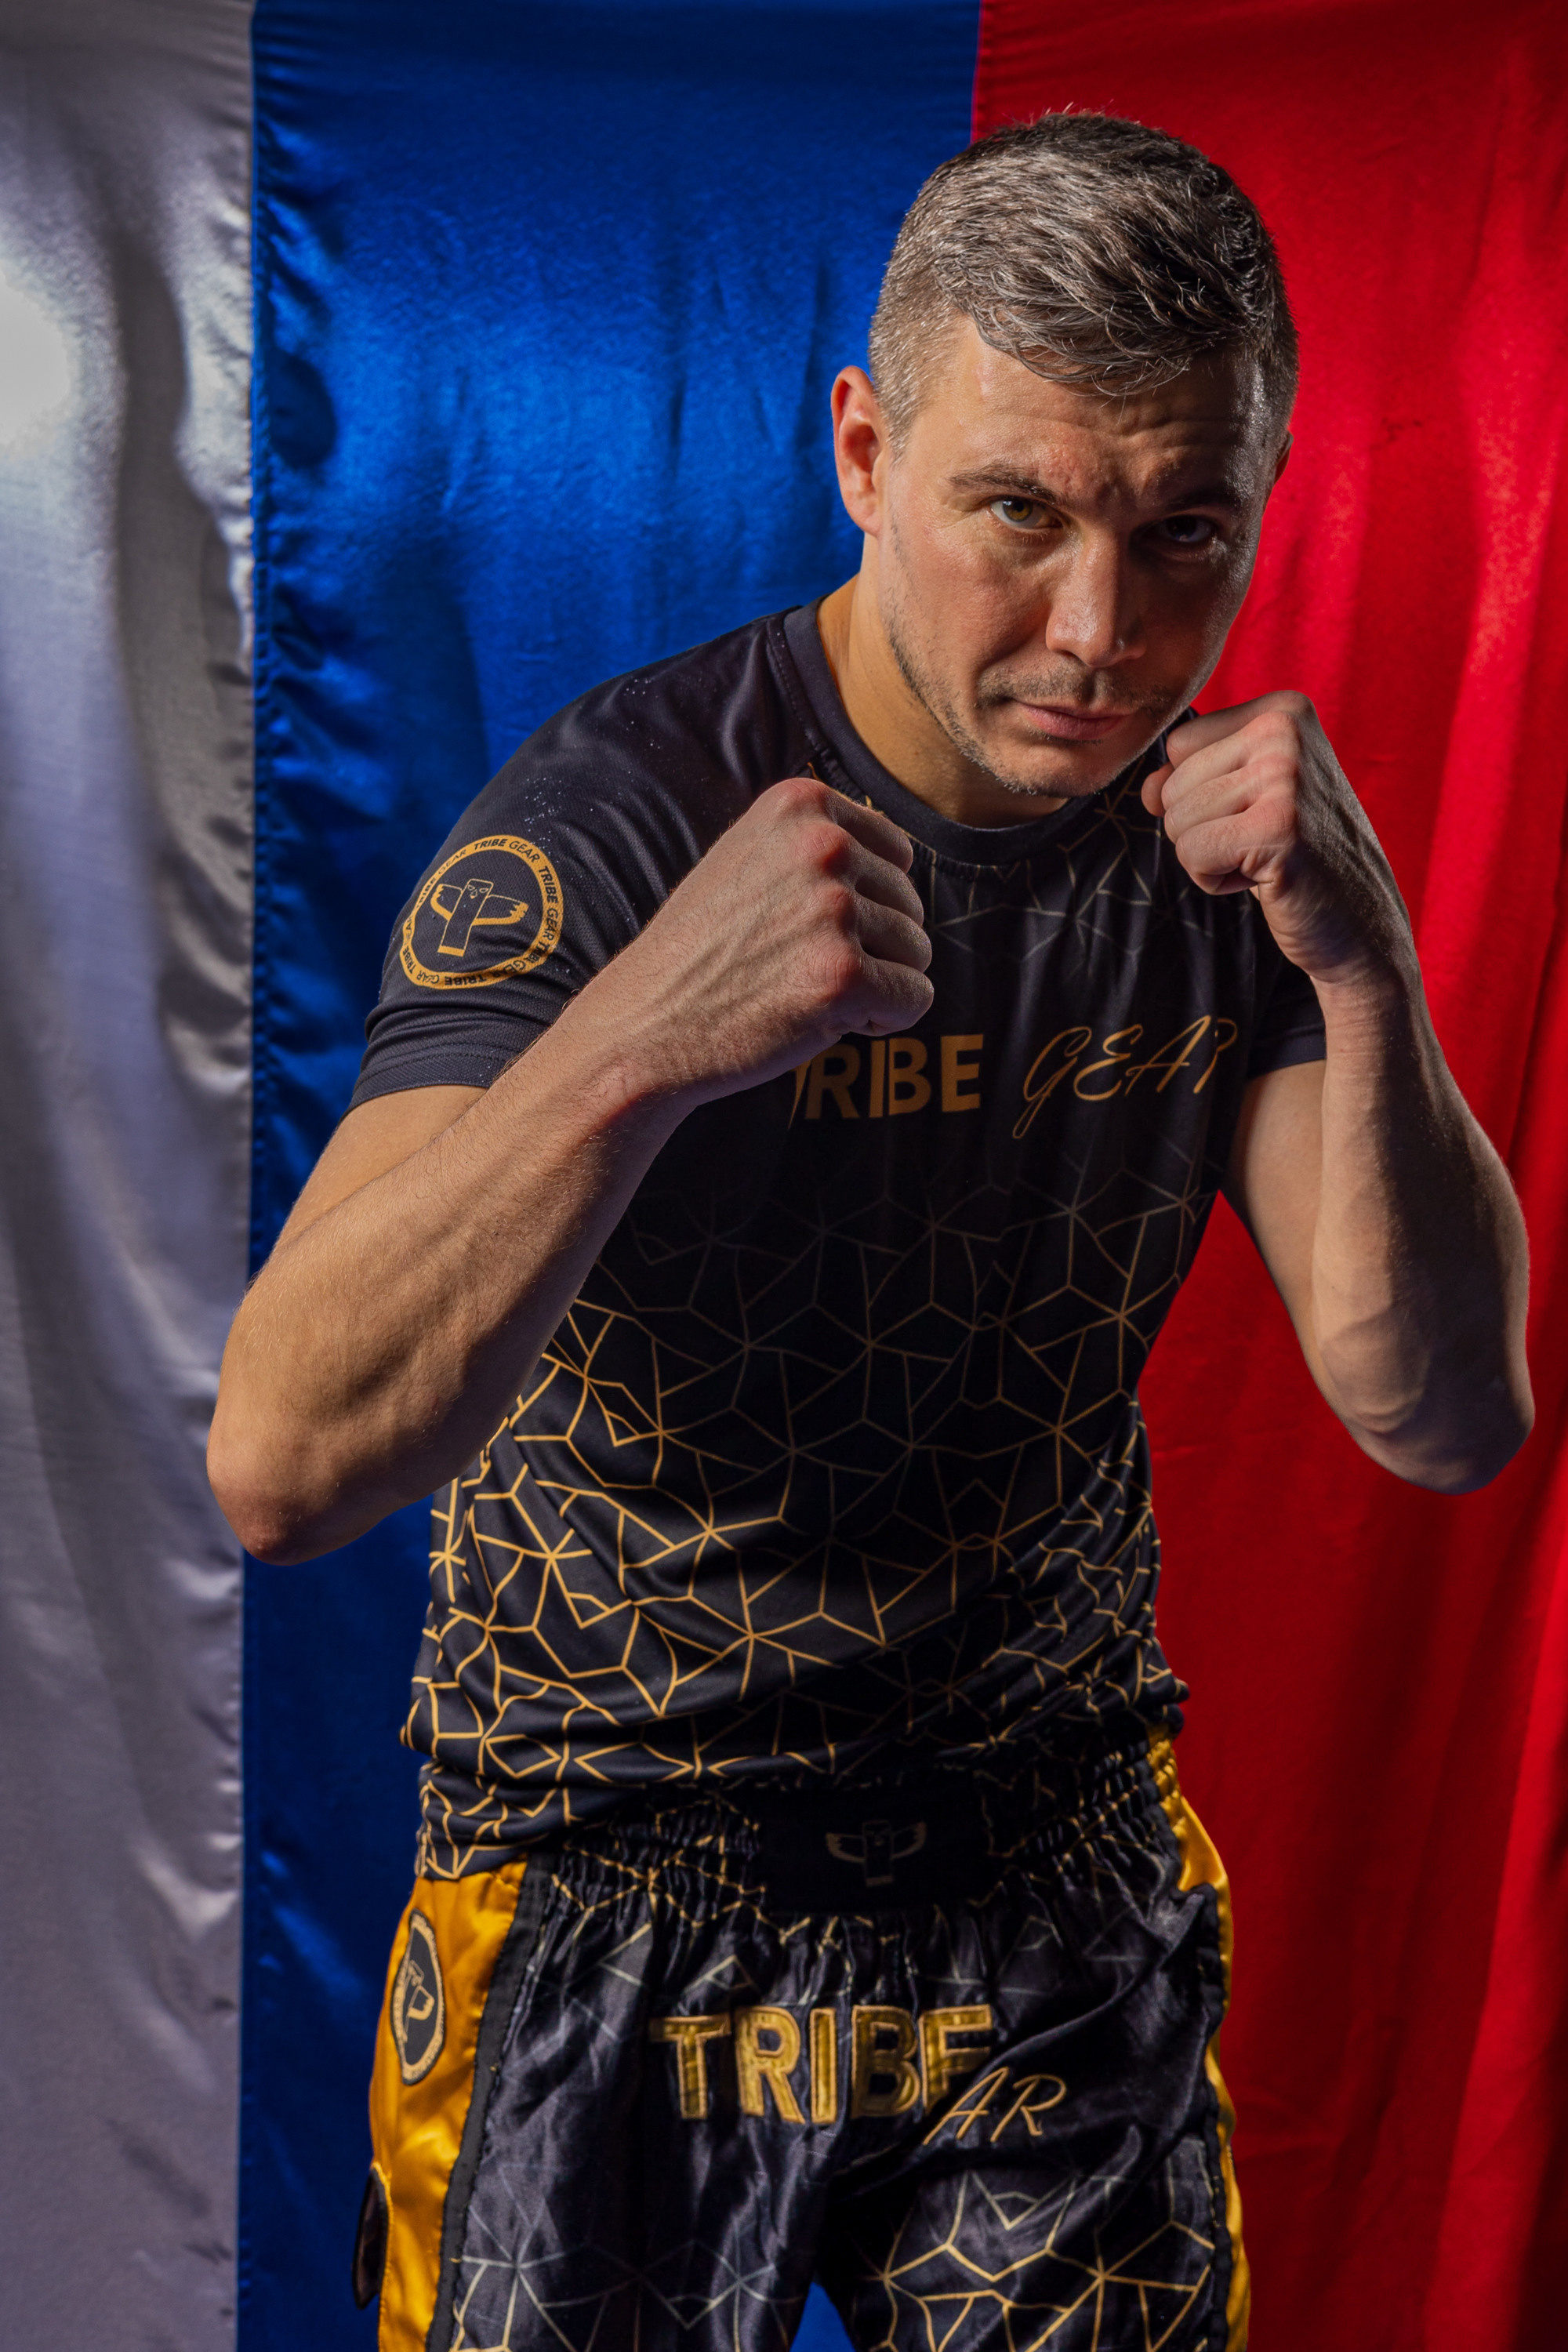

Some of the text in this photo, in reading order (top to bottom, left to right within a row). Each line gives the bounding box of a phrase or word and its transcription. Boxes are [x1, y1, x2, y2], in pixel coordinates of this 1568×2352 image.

[474, 838, 508, 851] TRIBE
[510, 840, 540, 862] GEAR
[539, 866, 558, 903] TRIBE
[546, 908, 559, 942] GEAR
[402, 946, 416, 974] TRIBE
[444, 975, 486, 986] TRIBE
[922, 2066, 1067, 2145] AR
